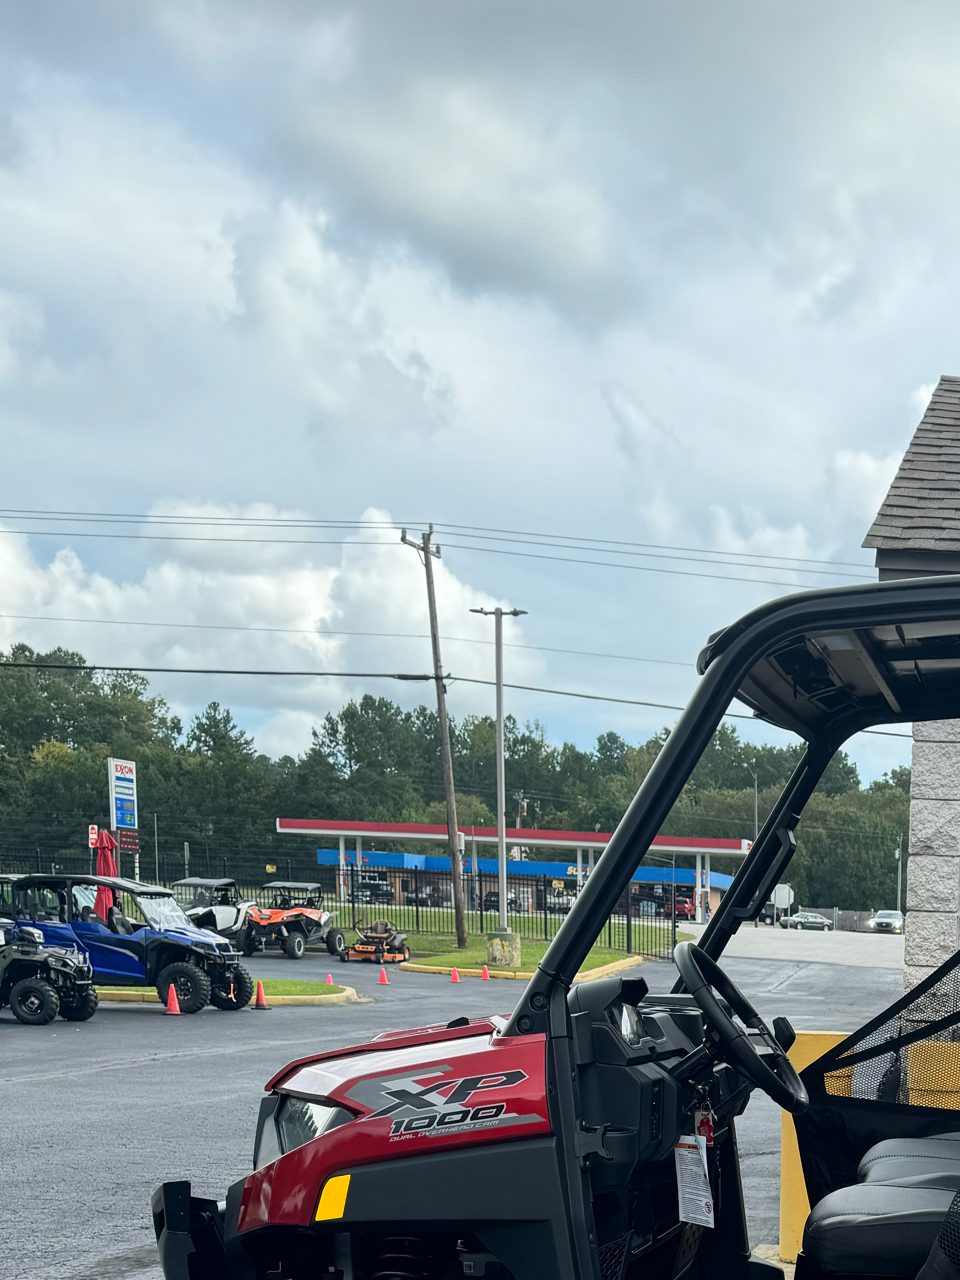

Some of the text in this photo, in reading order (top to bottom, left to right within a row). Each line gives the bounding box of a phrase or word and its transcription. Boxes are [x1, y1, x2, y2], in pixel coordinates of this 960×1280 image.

[356, 1069, 529, 1123] XP
[389, 1102, 506, 1136] 1000
[389, 1120, 500, 1142] DUAL OVERHEAD CAM
